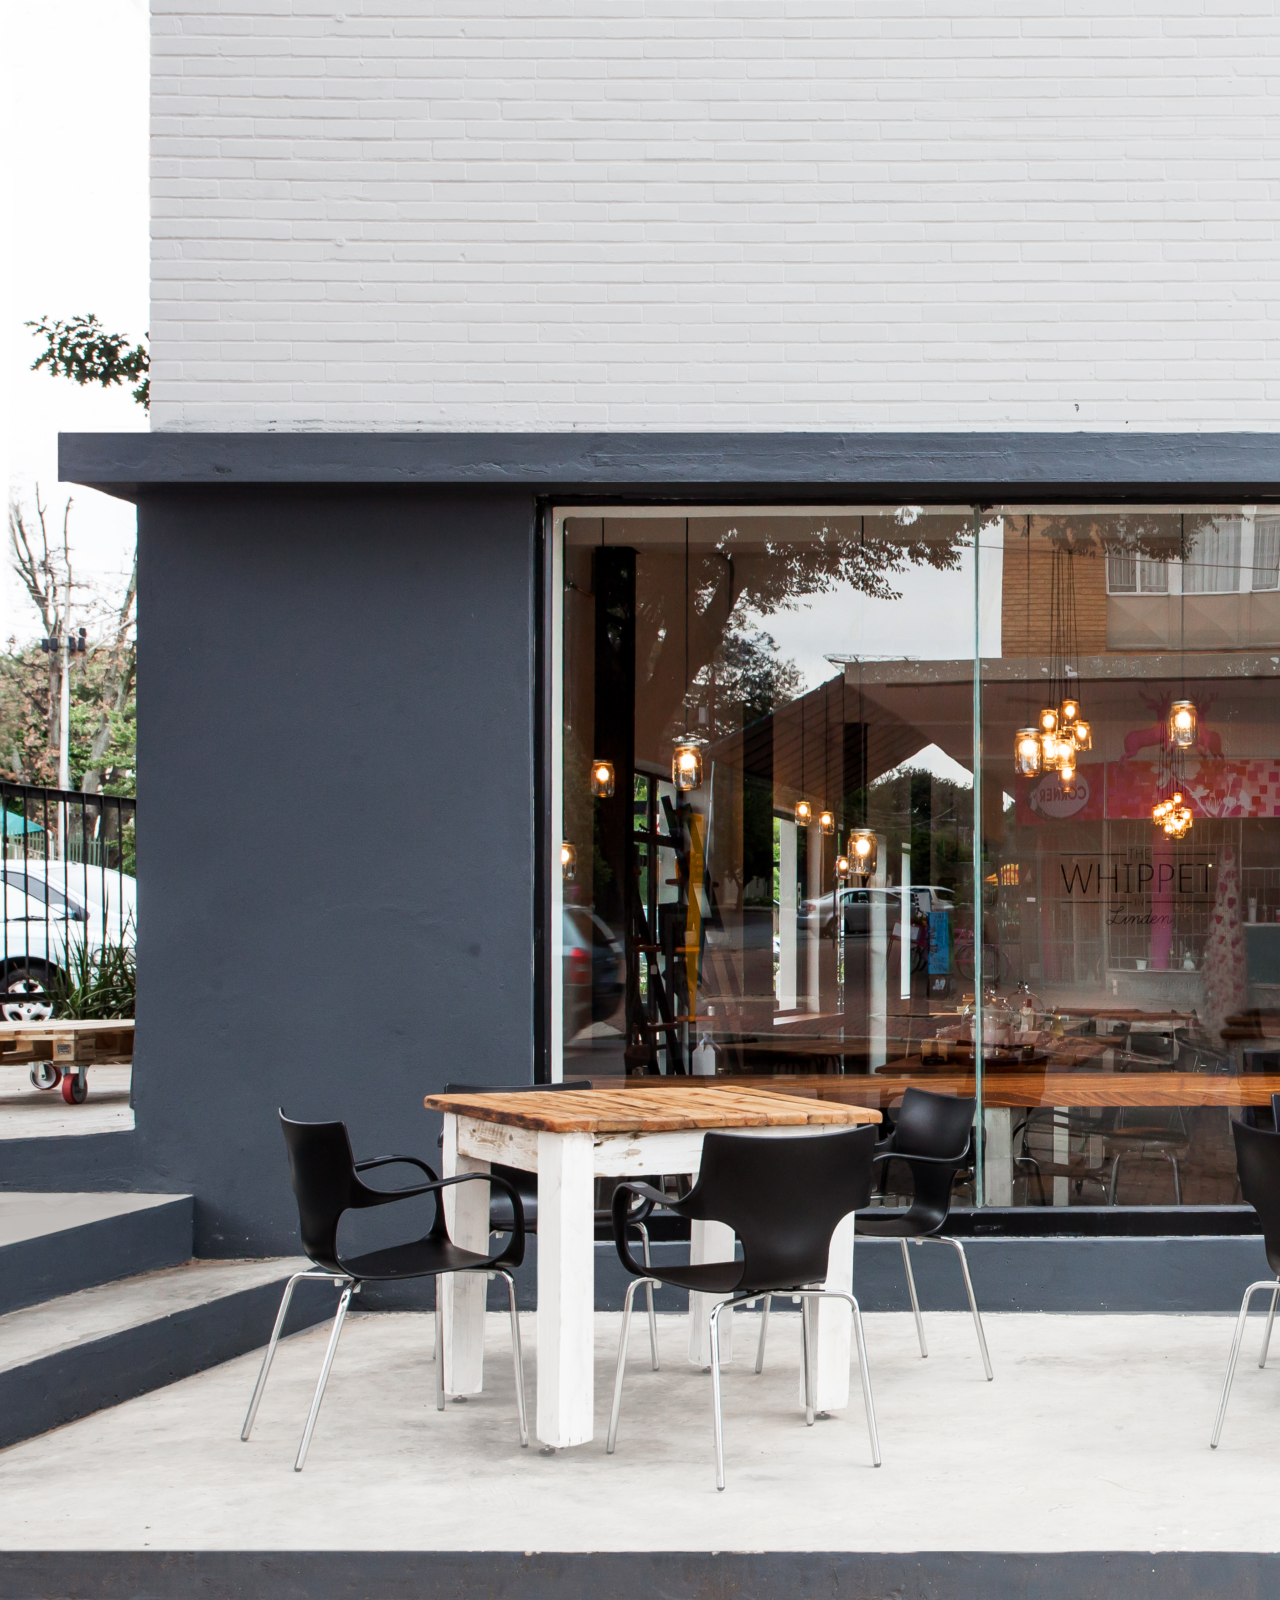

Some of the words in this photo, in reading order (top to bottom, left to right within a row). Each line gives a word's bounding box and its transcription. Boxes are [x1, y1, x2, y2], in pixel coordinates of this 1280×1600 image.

[1127, 848, 1150, 860] THE
[1060, 863, 1217, 894] WHIPPET
[1134, 898, 1144, 907] IN
[1106, 905, 1173, 926] Linden
